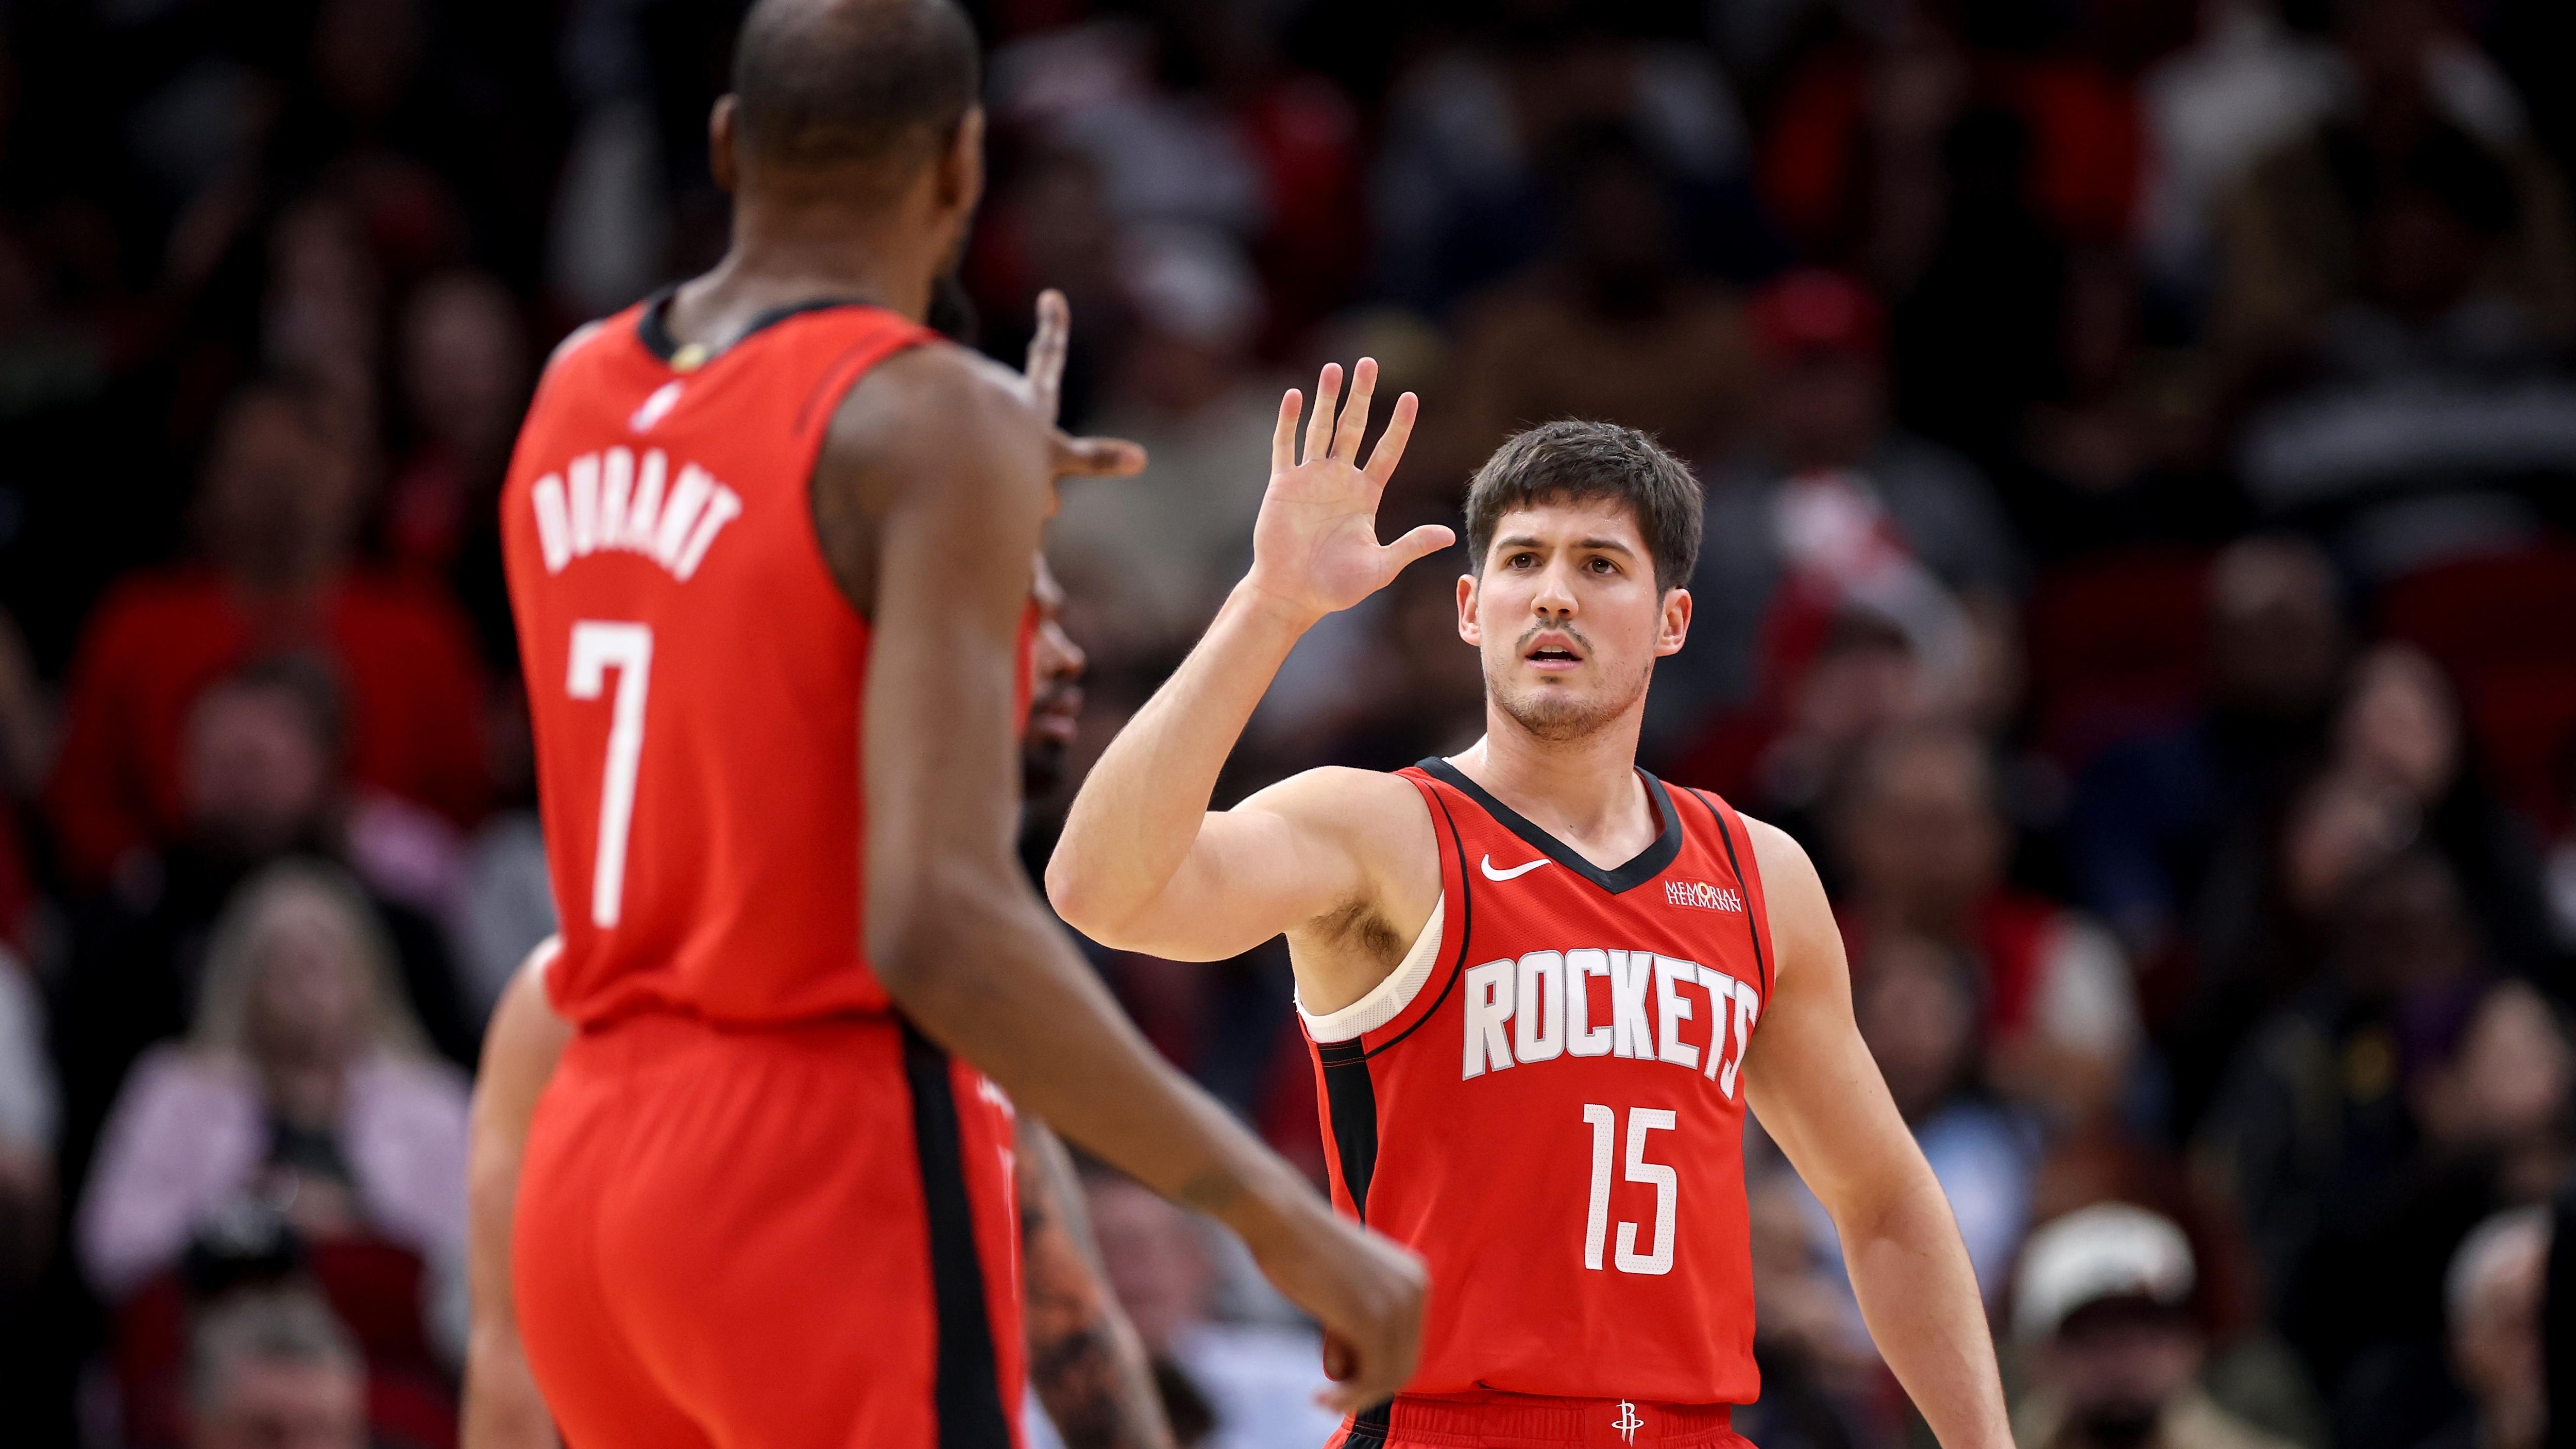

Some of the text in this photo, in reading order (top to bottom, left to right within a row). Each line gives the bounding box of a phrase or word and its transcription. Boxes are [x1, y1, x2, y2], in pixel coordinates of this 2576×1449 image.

[532, 446, 742, 582] DURANT
[567, 620, 653, 927] 7
[1665, 880, 1740, 901] MEMORIAL
[1667, 892, 1742, 912] HERMANN
[1462, 948, 1758, 1101] ROCKETS
[1583, 1103, 1677, 1275] 15
